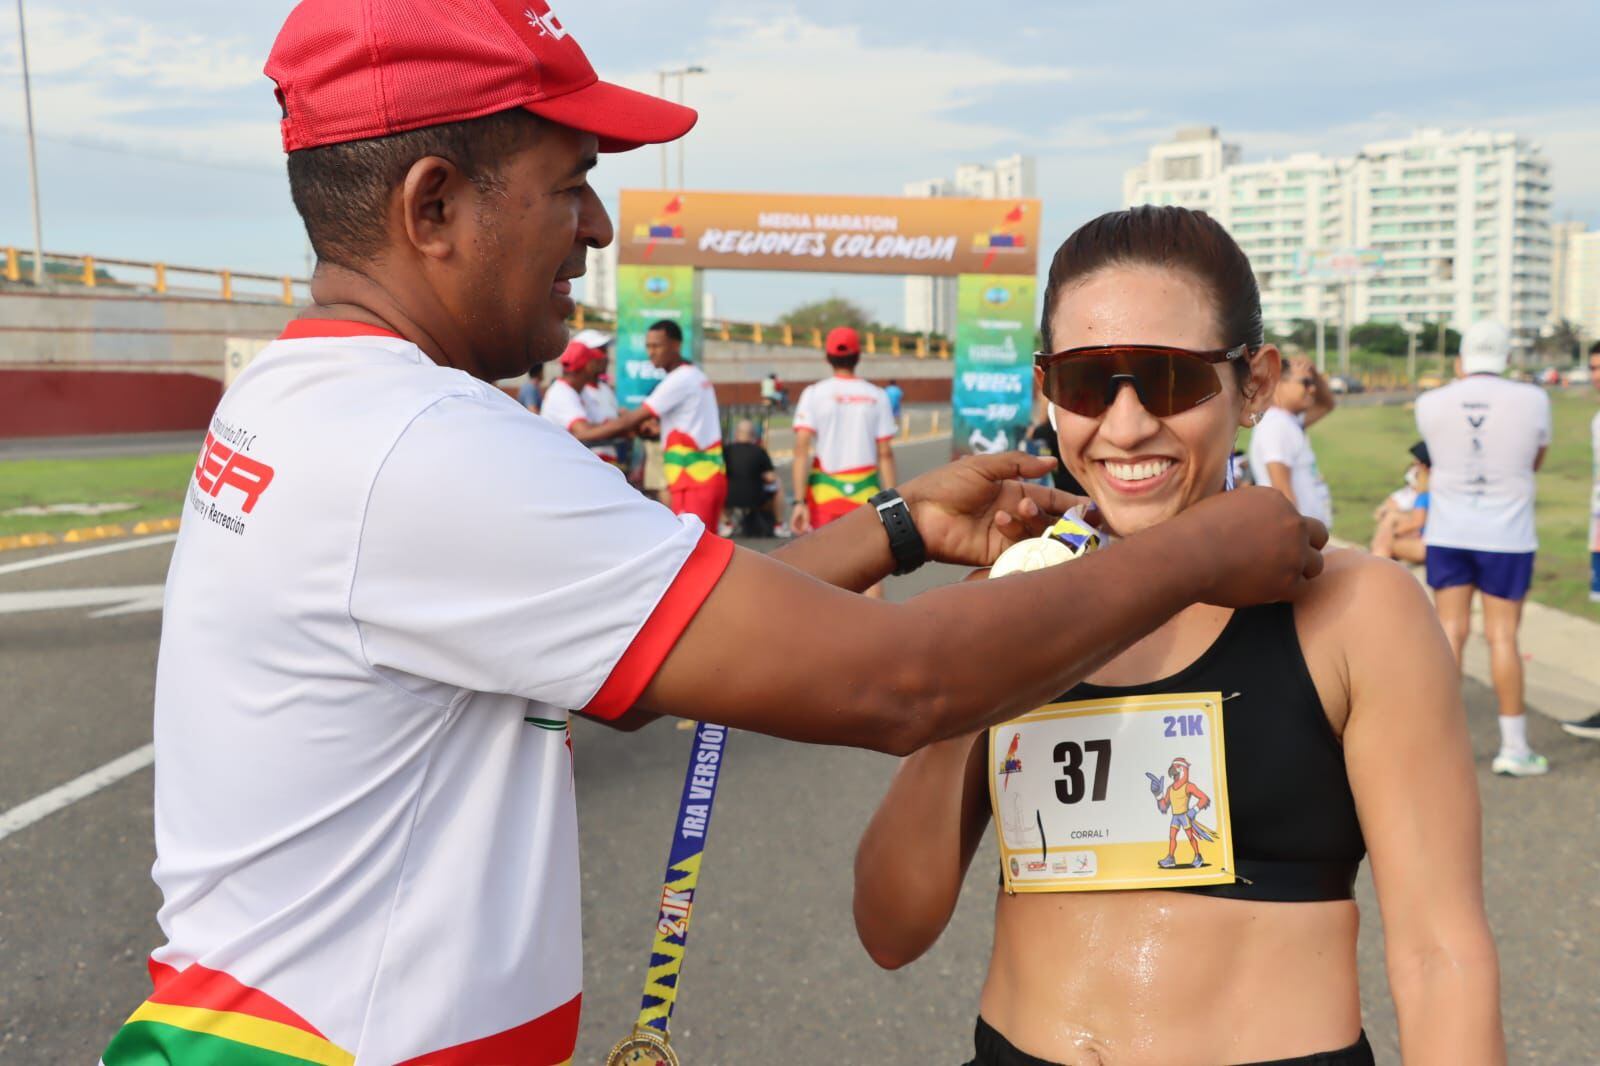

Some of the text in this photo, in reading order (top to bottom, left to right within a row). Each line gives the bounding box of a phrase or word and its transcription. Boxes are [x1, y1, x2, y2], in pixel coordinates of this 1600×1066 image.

[758, 211, 898, 232] MEDIA MARATON
[698, 228, 958, 262] REGIONES COLOMBIA
[208, 503, 246, 536] Recreación
[1163, 714, 1204, 738] 21K
[1053, 738, 1112, 805] 37
[681, 804, 707, 840] 1RA
[1070, 829, 1104, 840] CORRAL
[656, 885, 693, 939] 21K
